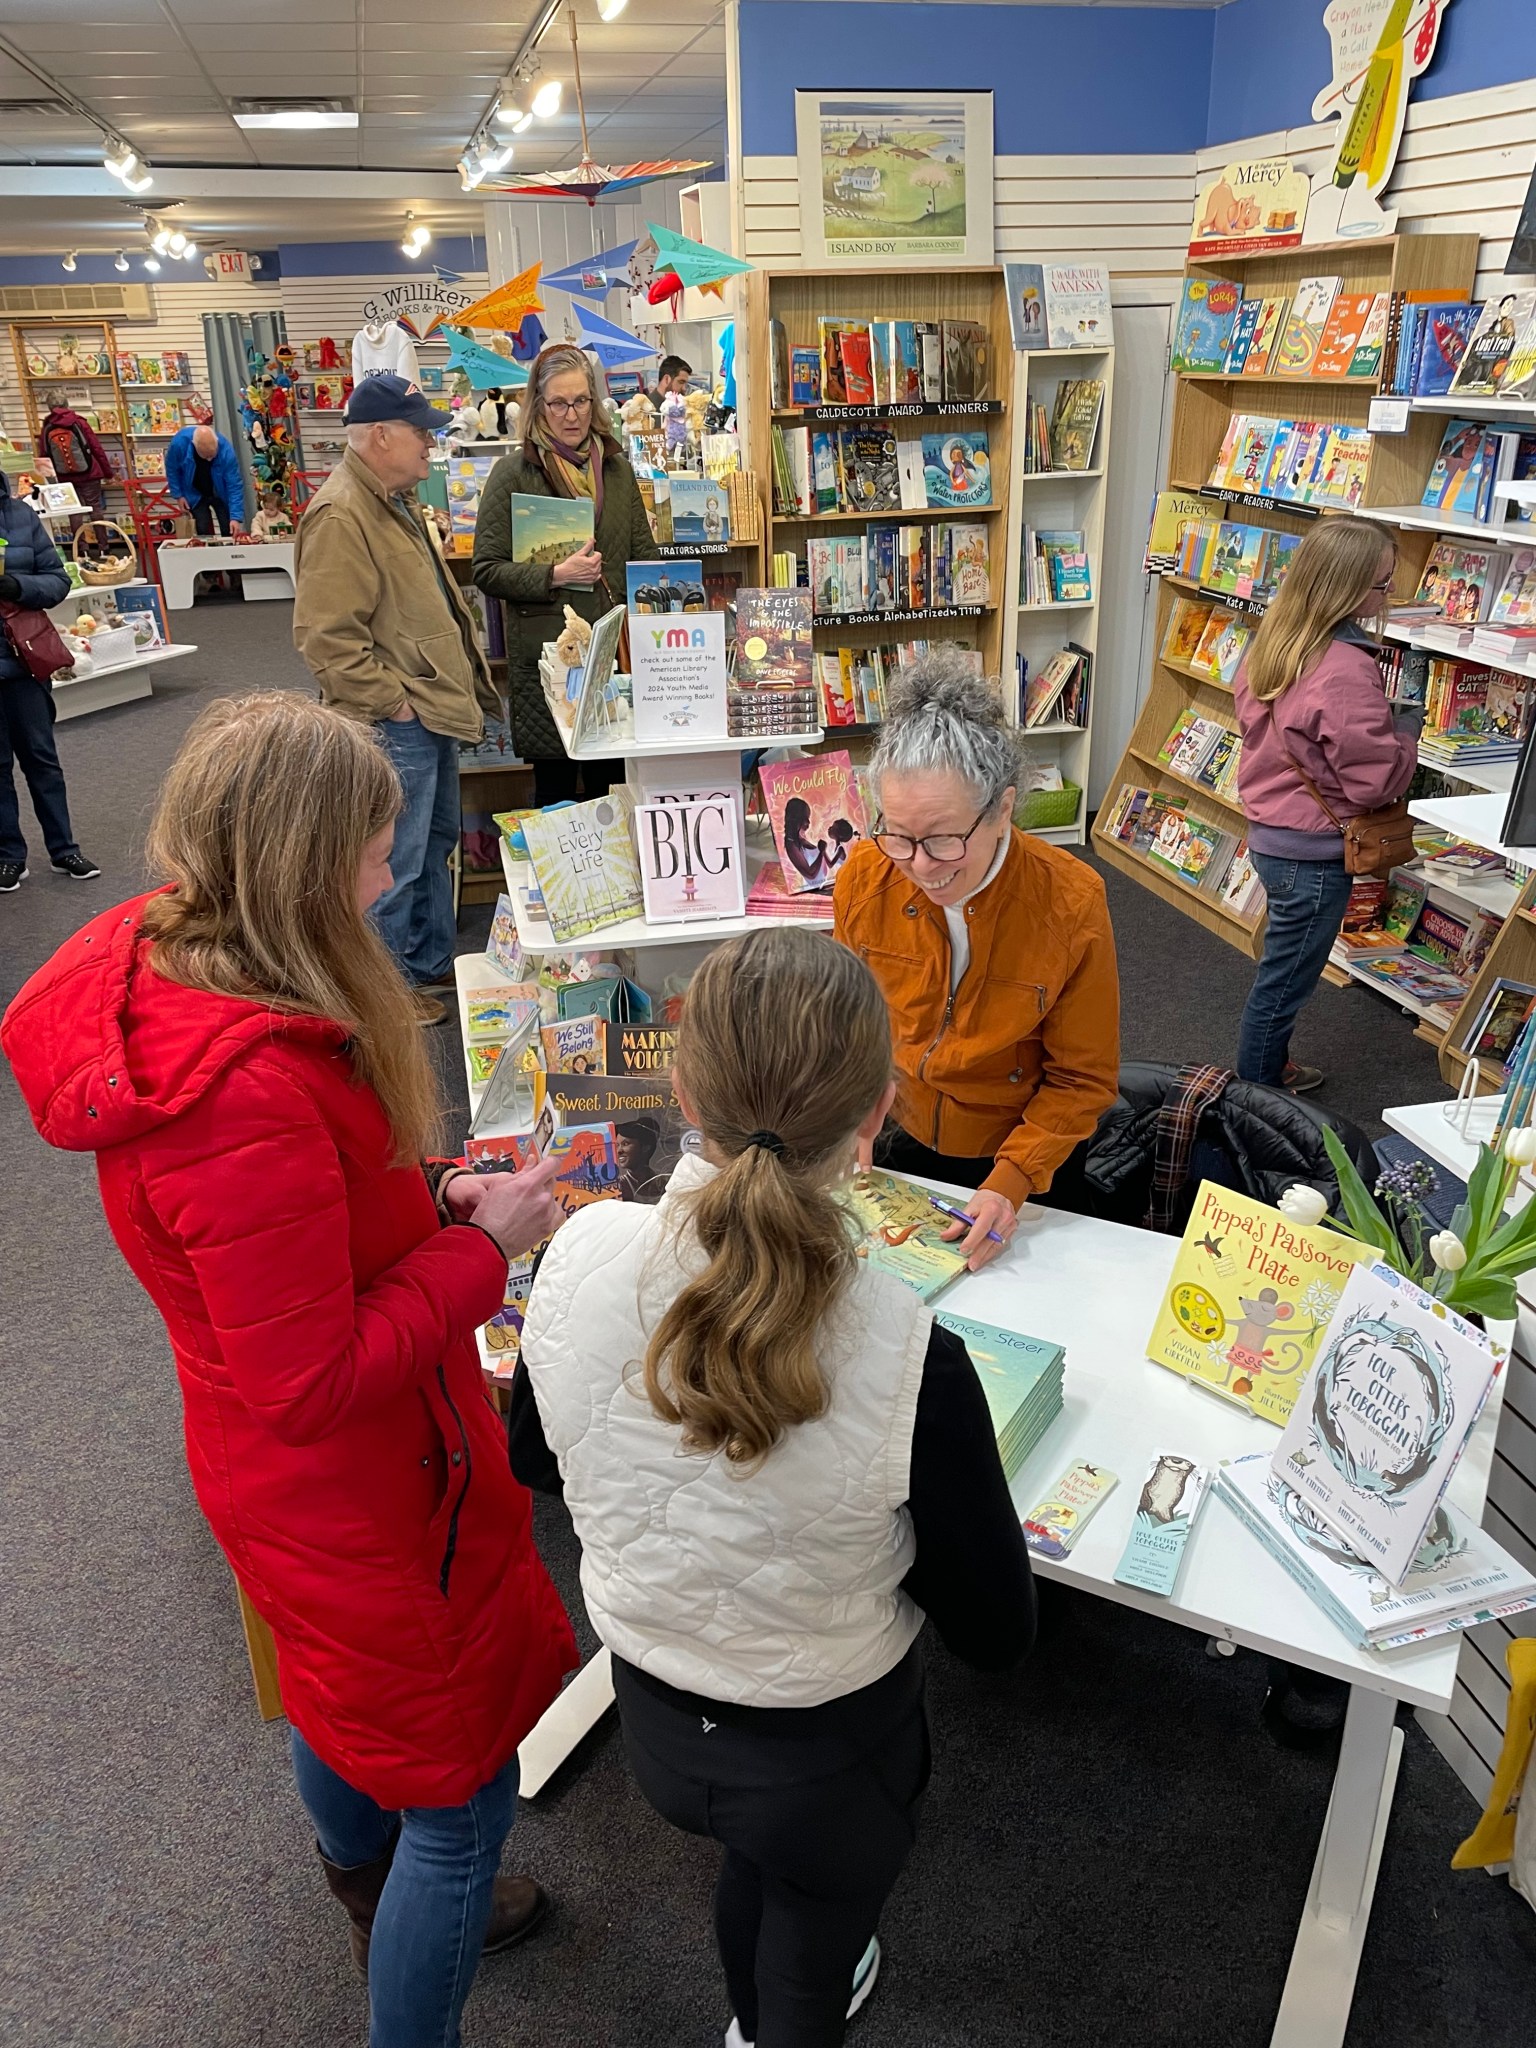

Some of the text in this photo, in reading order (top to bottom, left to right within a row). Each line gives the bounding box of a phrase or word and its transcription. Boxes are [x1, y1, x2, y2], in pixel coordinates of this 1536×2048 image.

[1331, 6, 1361, 25] Crayon
[1350, 22, 1372, 36] Place
[1351, 36, 1368, 54] Call
[1234, 165, 1287, 187] Mercy
[831, 242, 897, 254] ISLAND BOY
[906, 240, 960, 250] BARBARA COONEY
[219, 254, 244, 273] EXIT
[1056, 269, 1078, 280] WALK
[1079, 268, 1100, 279] WITH
[1051, 280, 1103, 293] VANESSA
[363, 283, 476, 320] G. Williker
[1209, 291, 1237, 306] LORAX
[1248, 300, 1260, 312] CAT
[1374, 298, 1389, 312] HO
[382, 304, 420, 322] BOOKS
[434, 305, 459, 317] TOY
[1240, 328, 1253, 338] HAT
[1366, 319, 1384, 334] POP
[1474, 335, 1515, 352] Lost Trail
[816, 402, 989, 419] CALDECOTT AWARD WINNERS
[640, 433, 665, 442] HOMER
[1332, 447, 1370, 462] Teacher
[821, 461, 831, 471] to
[676, 484, 718, 492] ISLAND BOY
[953, 482, 989, 504] PROTECTORS
[1169, 499, 1212, 519] Mercy
[1219, 490, 1240, 503] EARLY
[1243, 495, 1275, 511] READERS
[657, 545, 695, 556] TRATORS
[701, 544, 729, 554] STORIES
[962, 567, 983, 582] Home
[962, 579, 982, 595] Base
[751, 597, 798, 608] THE EYES
[1225, 595, 1244, 610] Kate
[761, 609, 792, 618] & THE
[813, 615, 842, 626] cTure
[848, 614, 880, 625] Books
[749, 618, 804, 631] IMPOSSIBLE
[651, 628, 705, 649] YMA
[640, 656, 660, 664] check
[694, 654, 703, 662] of
[705, 654, 716, 662] the
[682, 665, 708, 673] Library
[756, 668, 772, 676] DAVE
[1462, 672, 1489, 683] Inves
[665, 694, 693, 702] Winning
[772, 765, 847, 796] We Could Fly
[569, 820, 586, 834] In
[557, 830, 604, 855] Every
[645, 806, 733, 880] BIG
[570, 849, 604, 874] Life
[1430, 913, 1455, 934] CHOOSE
[1425, 919, 1439, 934] OWN
[1439, 925, 1464, 949] ADVENT
[555, 1023, 594, 1044] We Still
[621, 1031, 677, 1050] MAKIN
[558, 1036, 594, 1060] Belong
[555, 1090, 666, 1111] Sweet Dreams,
[1201, 1192, 1267, 1243] Pippa's
[1246, 1245, 1300, 1287] Plate
[938, 1315, 1046, 1355] lance, Steer
[1171, 1339, 1201, 1360] VIVIAN
[1164, 1347, 1202, 1372] KIRKFIELD
[1367, 1353, 1397, 1383] FOUR
[1264, 1387, 1296, 1407] illustrate
[1368, 1379, 1411, 1421] OTTERS
[1259, 1395, 1292, 1417] JILL WE
[1346, 1385, 1411, 1448] TOBOGGAN
[1135, 1536, 1177, 1552] TOBOGGAN
